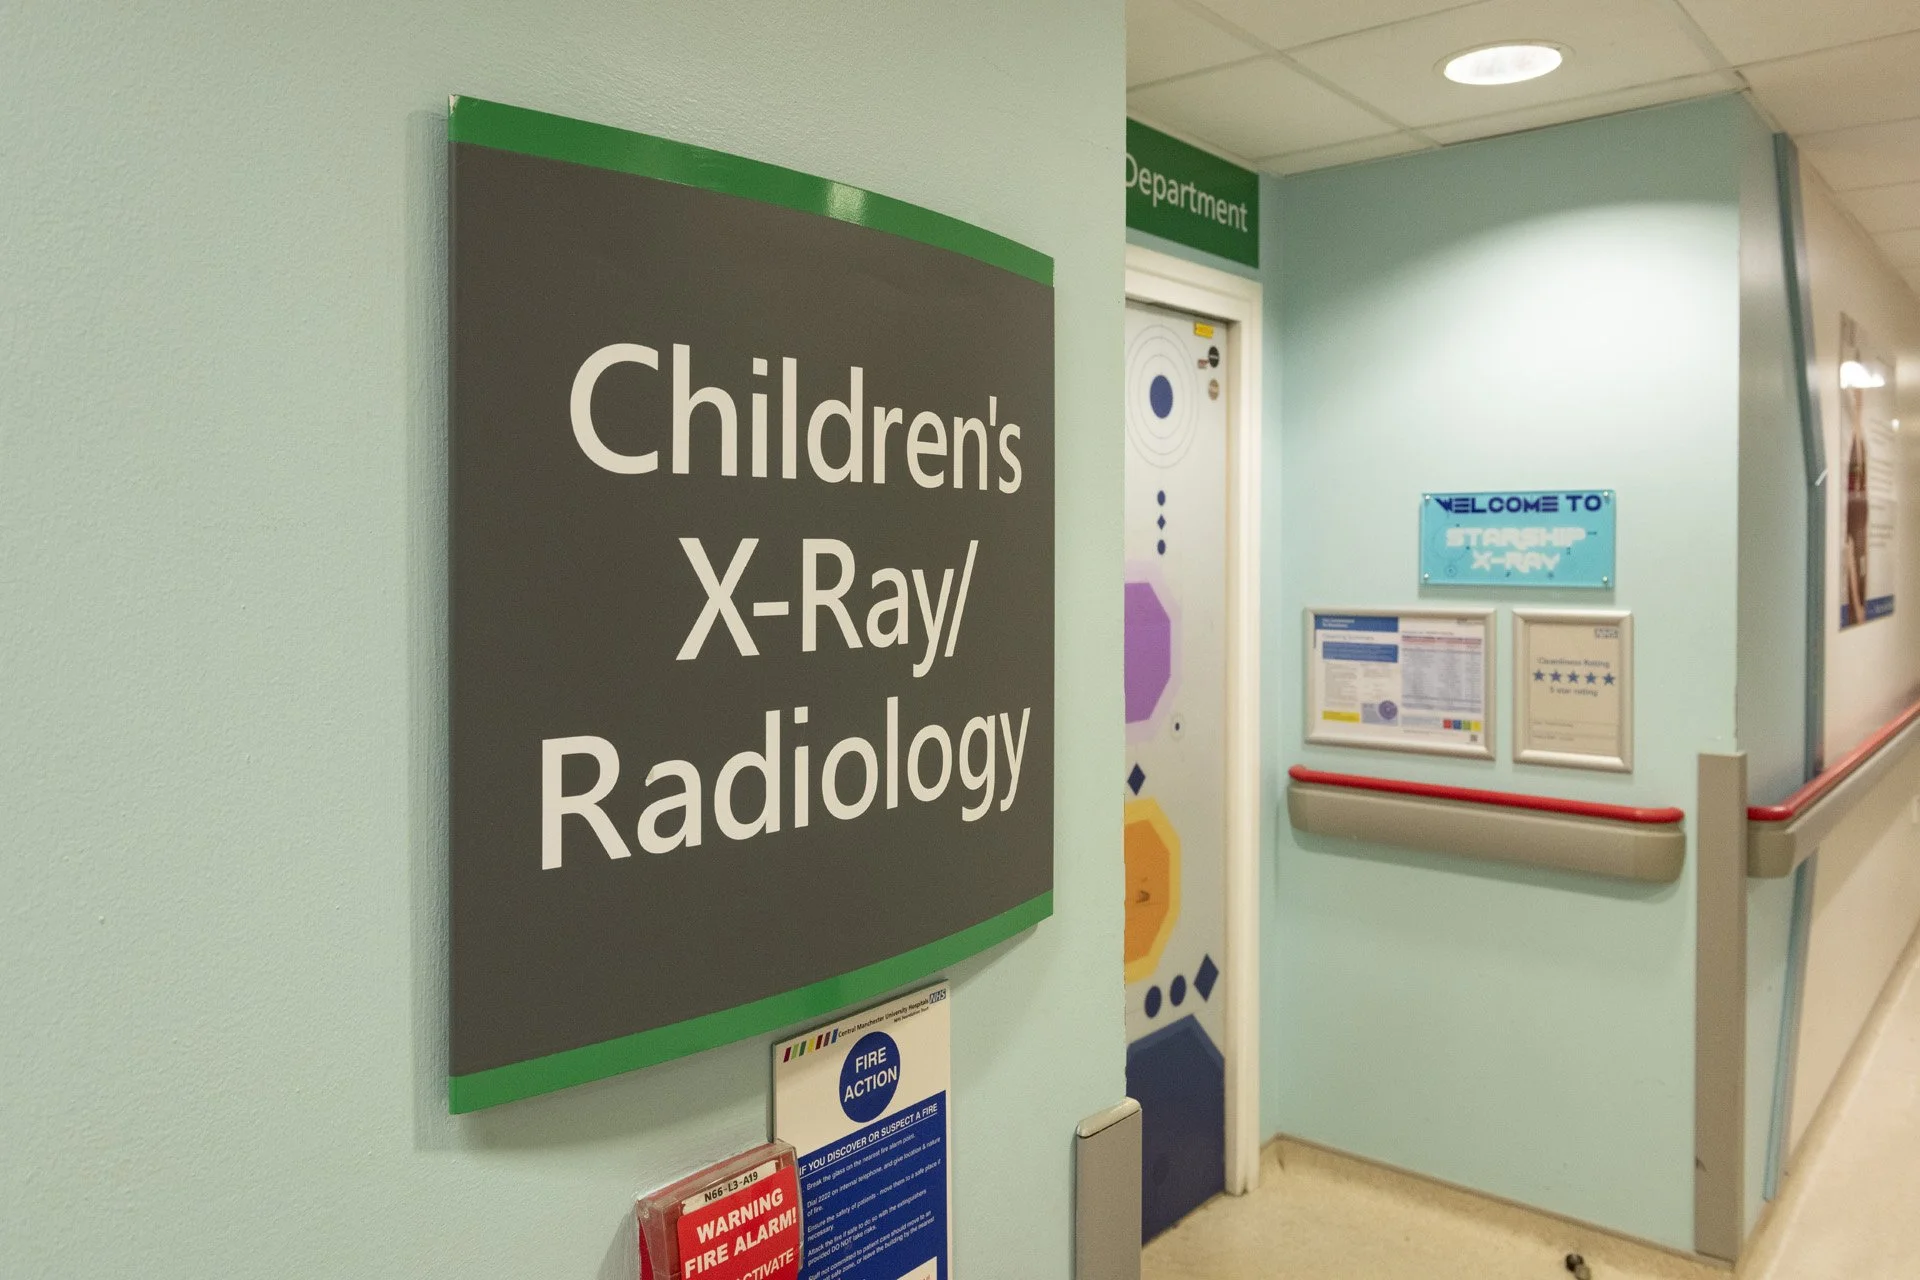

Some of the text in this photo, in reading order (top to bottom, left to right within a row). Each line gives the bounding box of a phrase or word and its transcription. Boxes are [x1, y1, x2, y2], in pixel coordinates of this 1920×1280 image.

[570, 342, 1023, 494] Children's
[1435, 494, 1603, 514] WELCOME TO
[1445, 526, 1587, 550] STARSHIP
[1471, 551, 1561, 573] X-RAY
[675, 537, 979, 678] X-Ray/
[541, 696, 1031, 871] Radiology
[930, 989, 946, 1004] NHS
[838, 998, 929, 1038] Central Manchester University Hospitals
[855, 1046, 887, 1074] FIRE
[843, 1065, 899, 1103] ACTION
[799, 1102, 938, 1176] IF YOU DISCOVER OR SUSPECT A FIRE
[807, 1178, 822, 1191] Break
[822, 1174, 832, 1183] the
[832, 1168, 845, 1180] glass
[846, 1163, 853, 1171] on
[853, 1159, 862, 1168] the
[862, 1150, 880, 1163] nearest
[880, 1146, 889, 1155] fire
[889, 1139, 902, 1151] alarm
[807, 1197, 818, 1209] Dial
[831, 1188, 839, 1196] on
[839, 1178, 858, 1192] internal
[883, 1160, 893, 1170] and
[893, 1155, 904, 1166] give
[903, 1146, 922, 1160] location
[926, 1137, 941, 1148] nature
[704, 1171, 759, 1203] N66-L3-A19
[807, 1219, 826, 1233] Ensure
[826, 1214, 836, 1224] the
[835, 1206, 851, 1219] safety
[879, 1184, 893, 1196] move
[914, 1167, 925, 1177] safe
[924, 1160, 938, 1173] place
[696, 1187, 784, 1245] WARNING
[807, 1209, 813, 1218] of
[684, 1206, 797, 1279] FIRE ALARM!
[807, 1248, 831, 1268] provided
[831, 1243, 840, 1253] DO
[840, 1235, 853, 1248] NOT
[852, 1230, 864, 1241] take
[808, 1244, 825, 1257] Attack
[825, 1238, 834, 1248] the
[833, 1233, 843, 1243] fire
[847, 1225, 858, 1236] safe
[858, 1222, 864, 1230] to
[736, 1247, 794, 1280] CTIVATE
